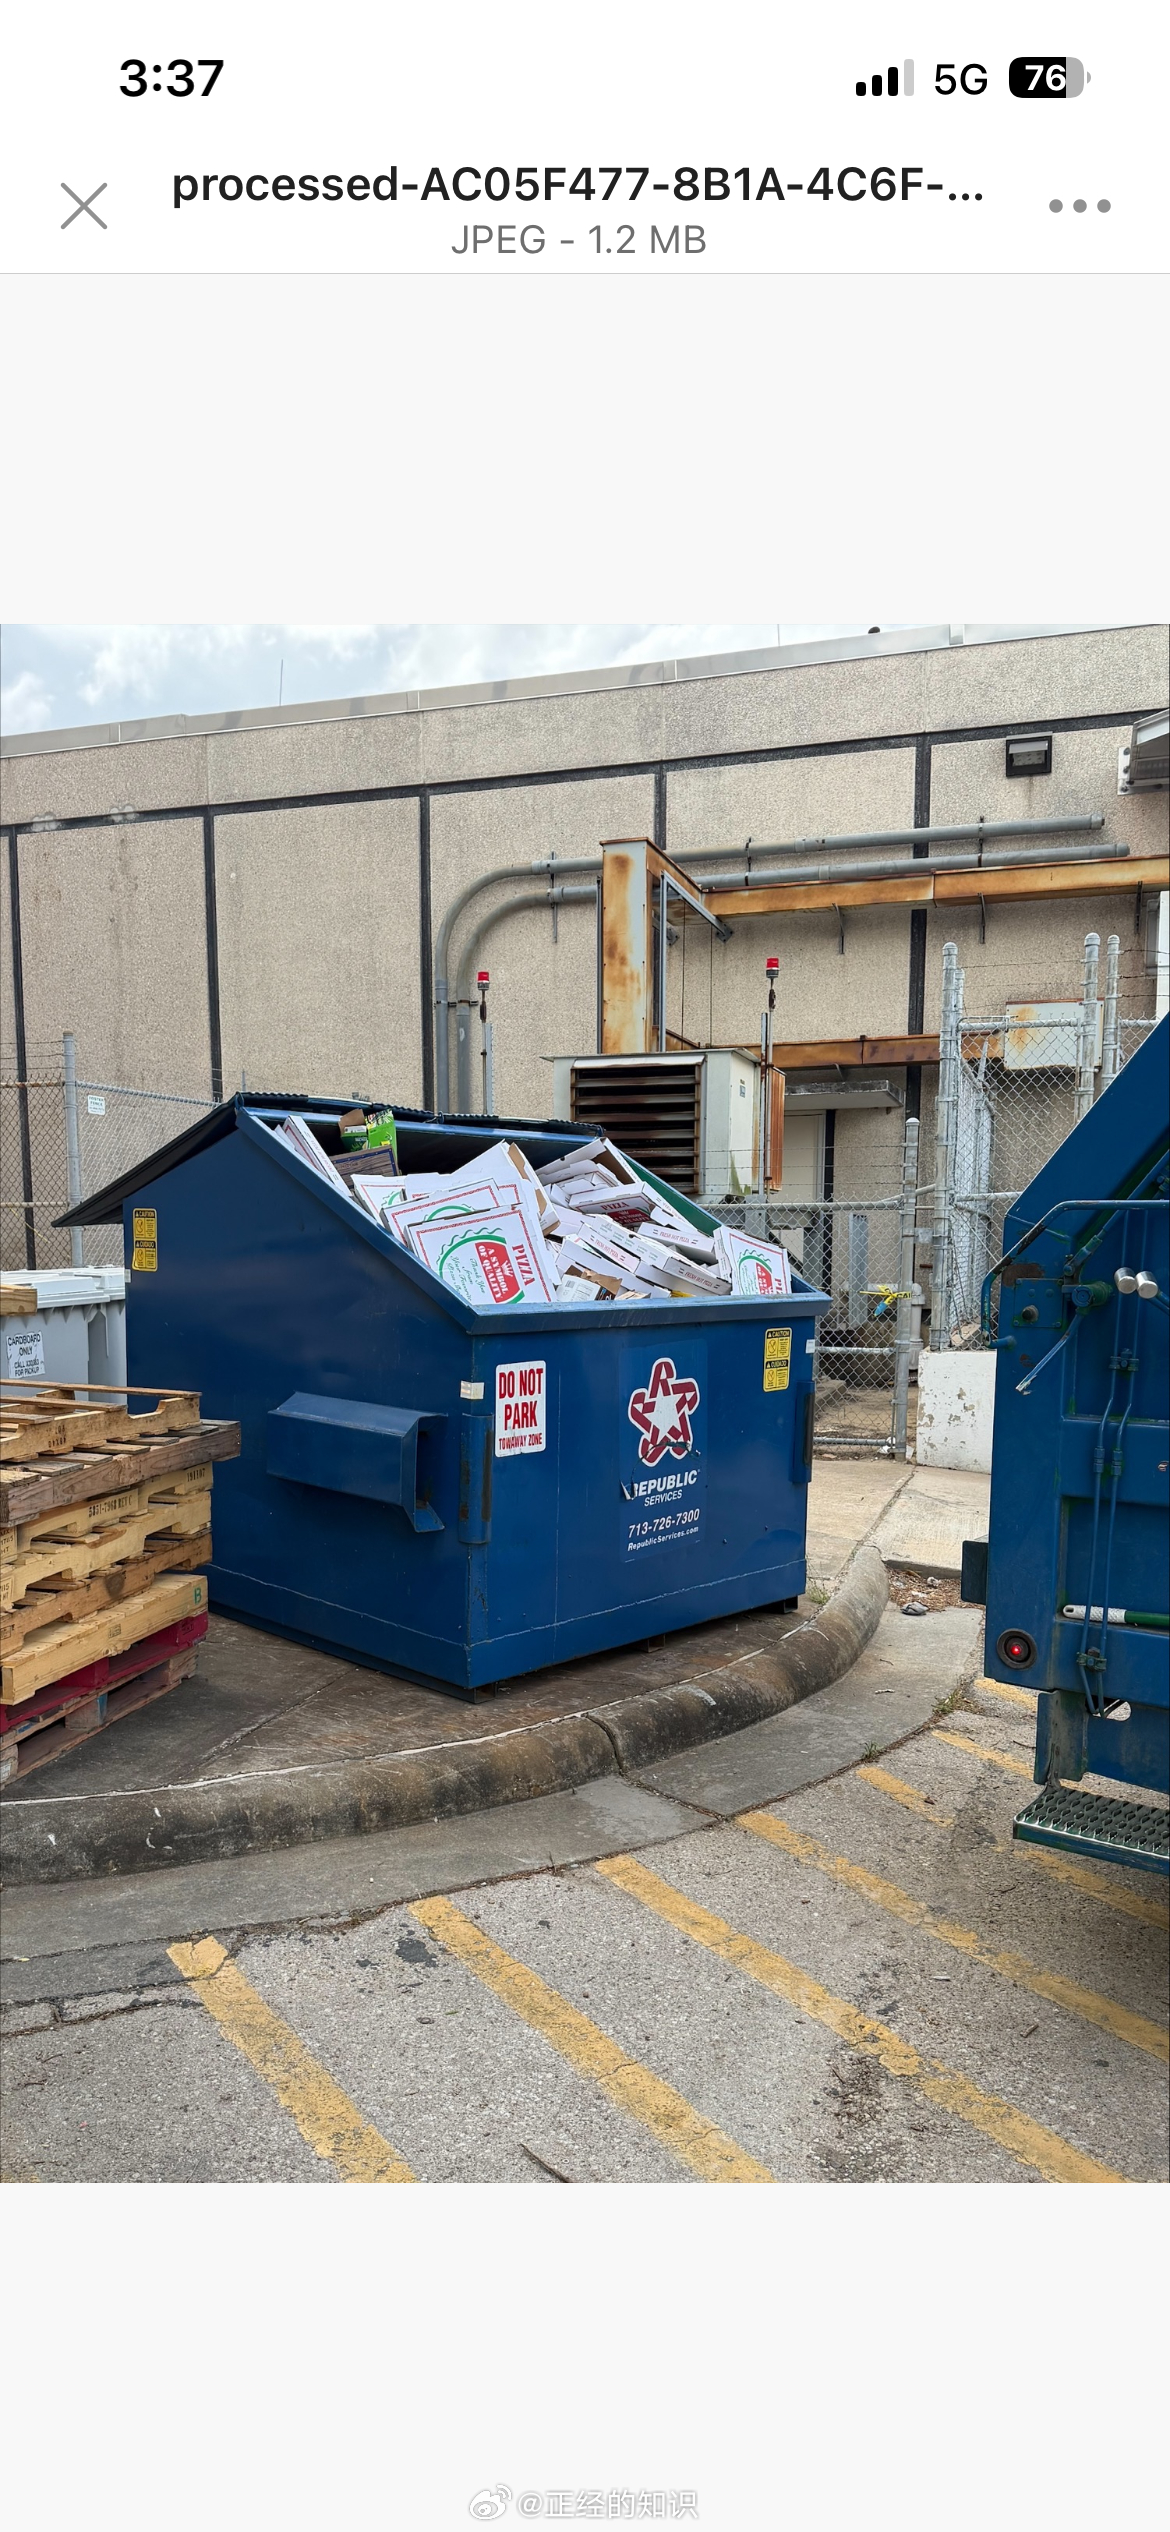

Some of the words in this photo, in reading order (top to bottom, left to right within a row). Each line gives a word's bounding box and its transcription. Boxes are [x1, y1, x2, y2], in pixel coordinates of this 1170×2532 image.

[601, 1201, 629, 1211] PIZZA
[478, 1245, 488, 1258] OF
[511, 1243, 536, 1286] PIZZA
[482, 1259, 503, 1299] QUALITY
[490, 1256, 509, 1294] SYMBOL
[8, 1334, 40, 1346] CARDBOARD
[19, 1346, 33, 1356] ONLY
[15, 1368, 24, 1377] FOR
[499, 1371, 515, 1399] DO
[519, 1368, 543, 1397] NOT
[504, 1400, 538, 1431] PARK
[499, 1434, 527, 1450] TOWAWAY
[528, 1432, 542, 1446] ZONE
[644, 1489, 683, 1507] SERVICES
[628, 1508, 700, 1539] 713-726-7300
[627, 1526, 699, 1552] RepublicServices.com
[194, 1587, 202, 1605] B
